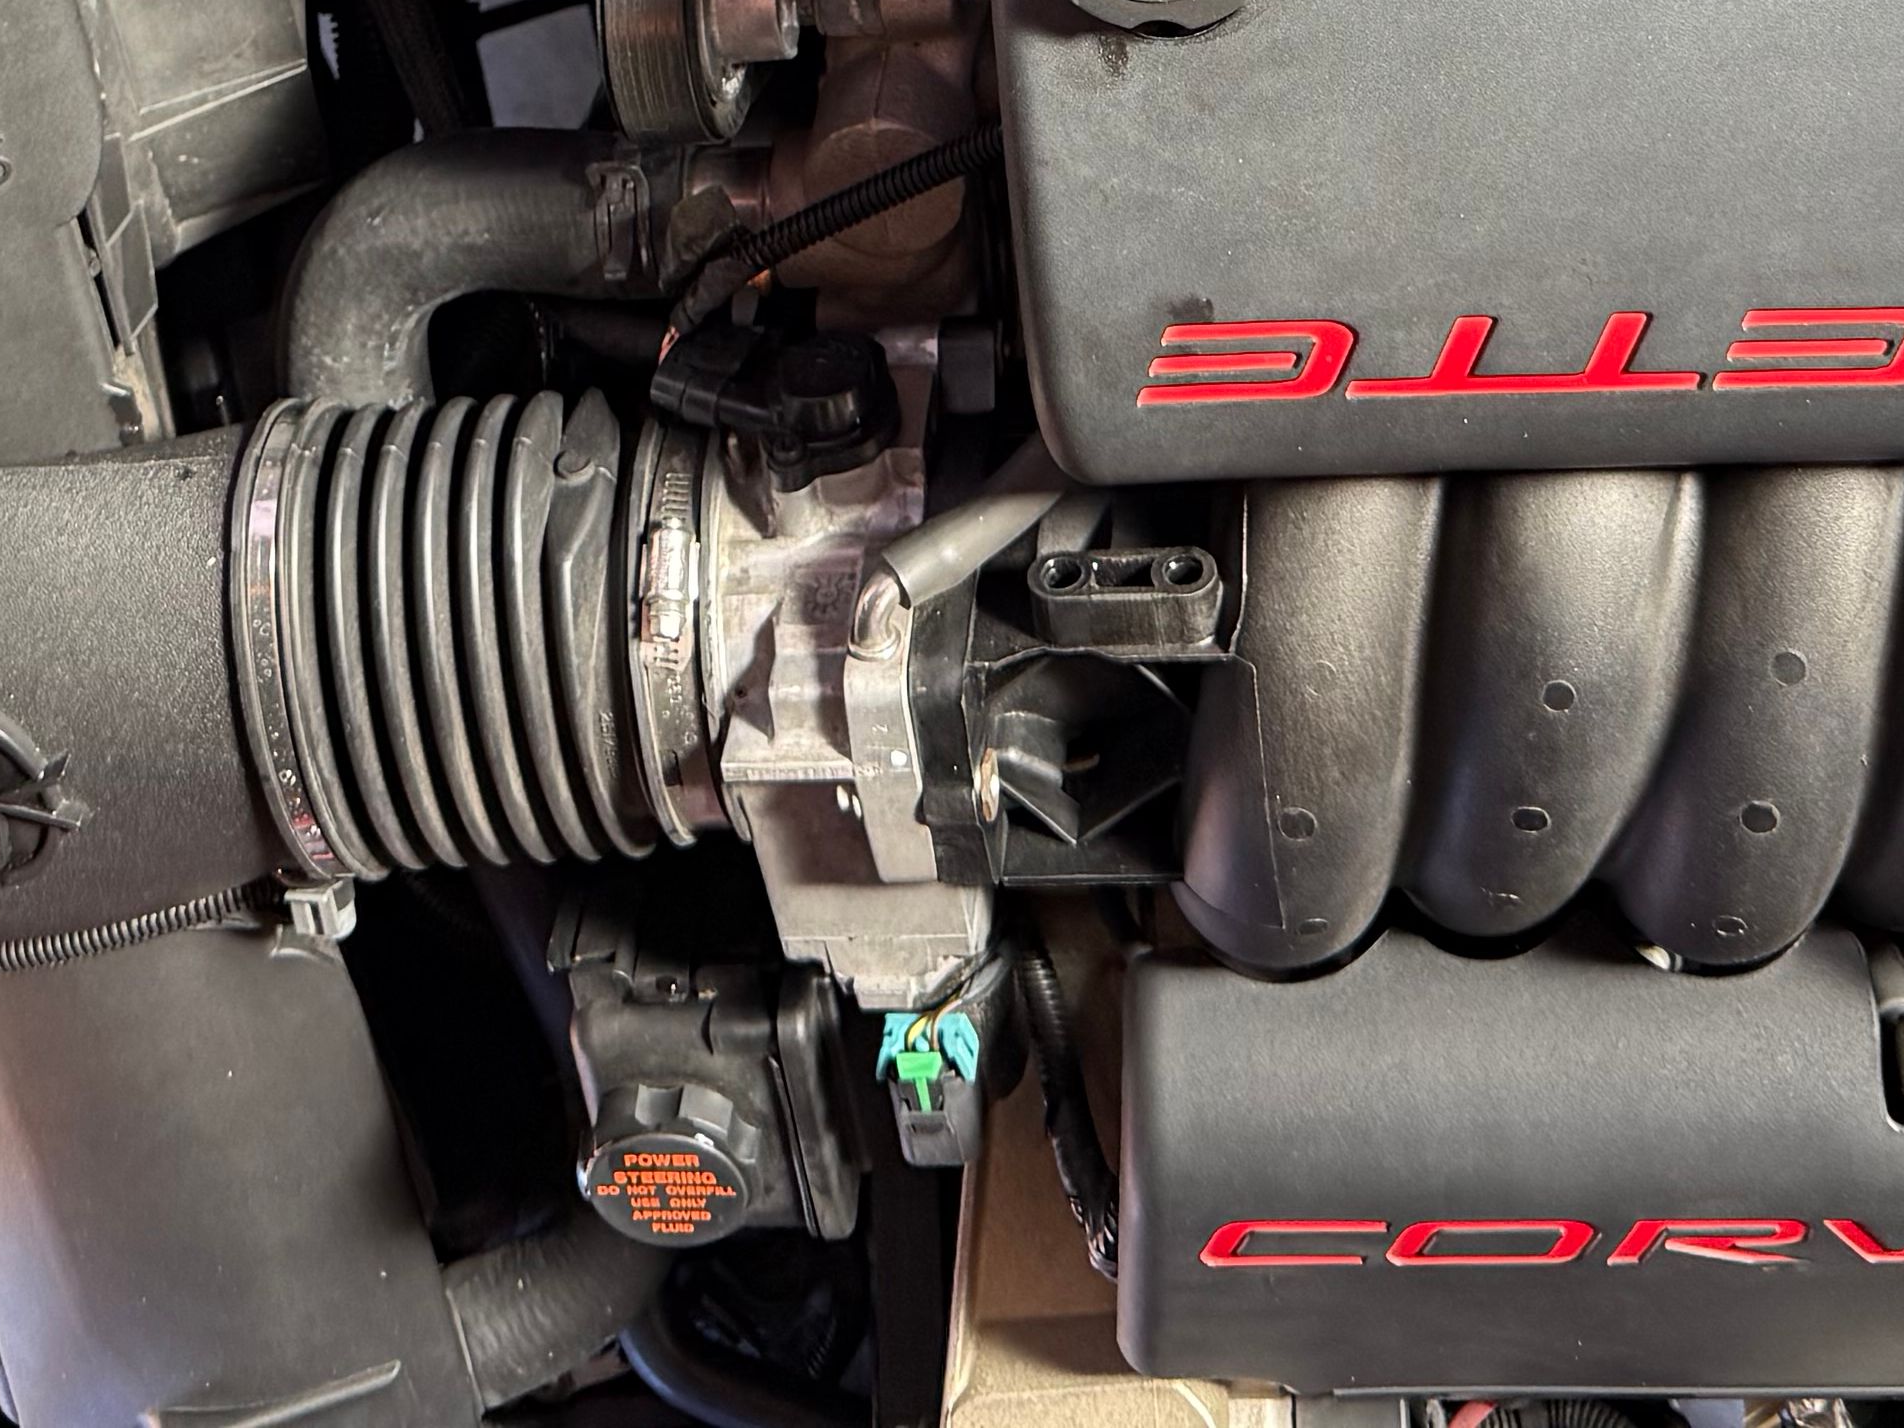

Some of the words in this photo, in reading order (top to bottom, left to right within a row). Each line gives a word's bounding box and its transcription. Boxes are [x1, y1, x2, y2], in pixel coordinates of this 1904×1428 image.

[623, 1153, 700, 1167] POWER
[613, 1171, 717, 1185] STEERING
[596, 1185, 620, 1196] DO
[627, 1185, 657, 1196] NOT
[631, 1197, 660, 1208] USE
[669, 1198, 707, 1208] ONLY
[632, 1210, 711, 1221] APPROVED
[652, 1222, 694, 1233] FLUID
